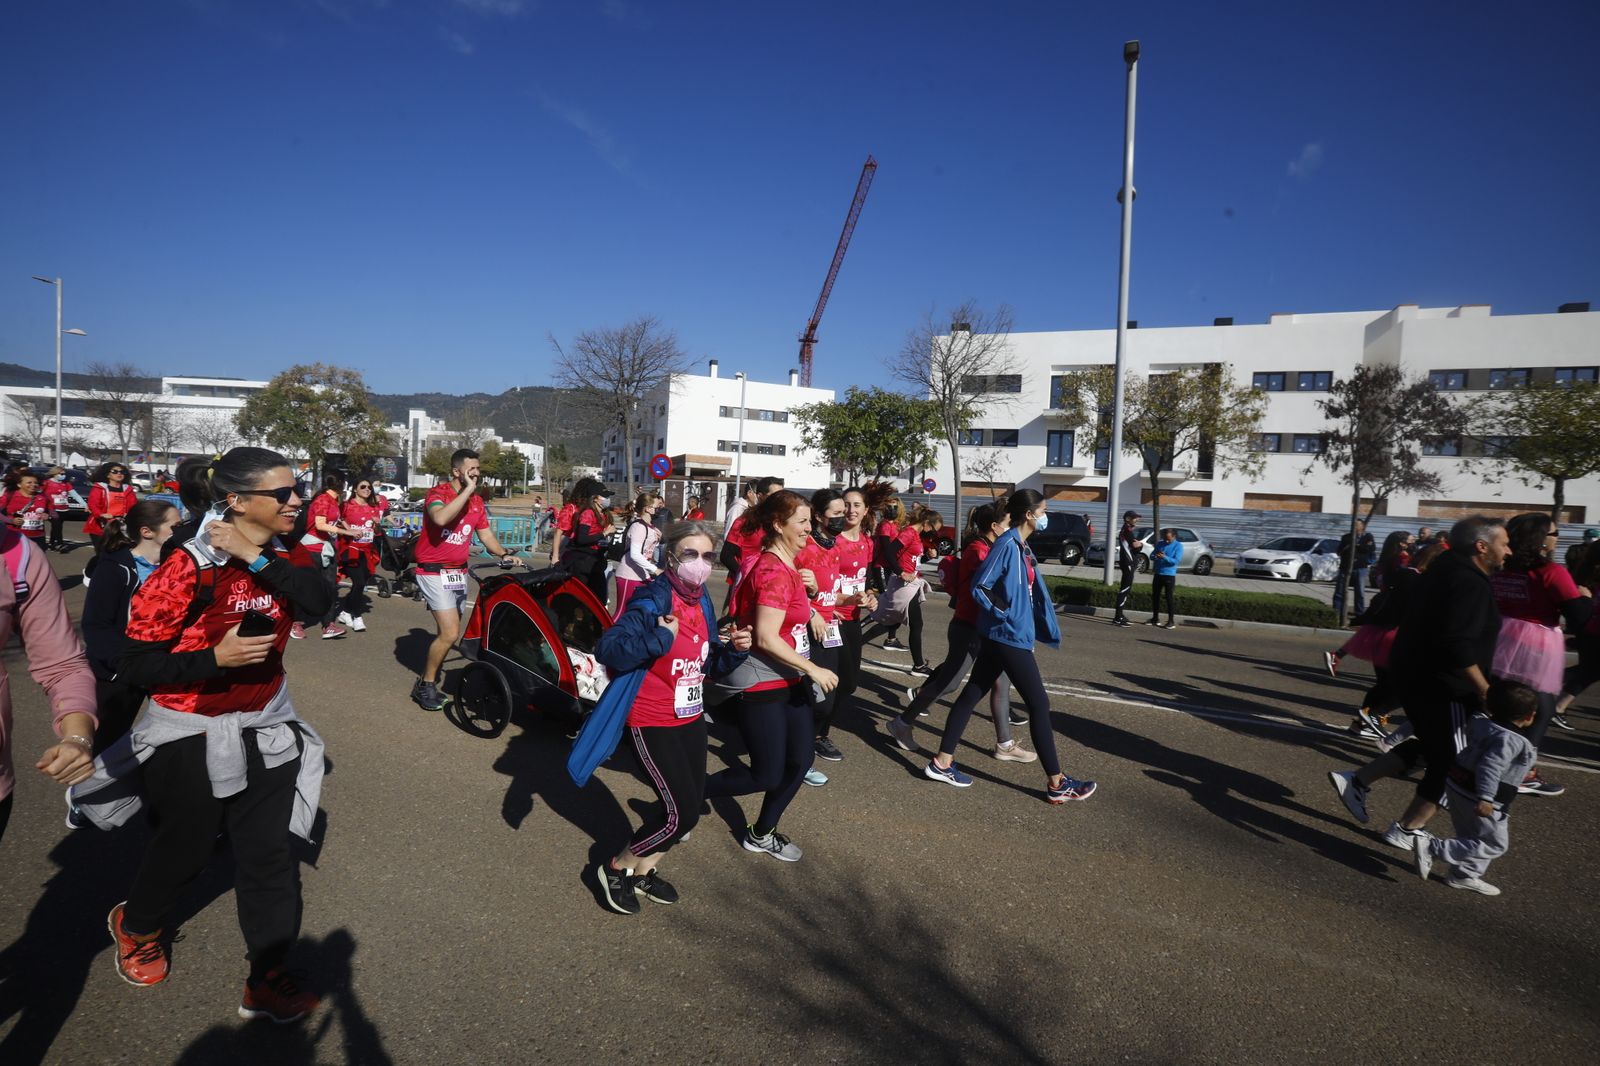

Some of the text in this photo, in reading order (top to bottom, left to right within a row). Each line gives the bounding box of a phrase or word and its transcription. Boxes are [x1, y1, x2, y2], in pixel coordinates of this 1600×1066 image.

[441, 528, 463, 542] Pink
[227, 591, 252, 606] PIN
[235, 594, 272, 612] RUNNI
[671, 656, 701, 677] Pink
